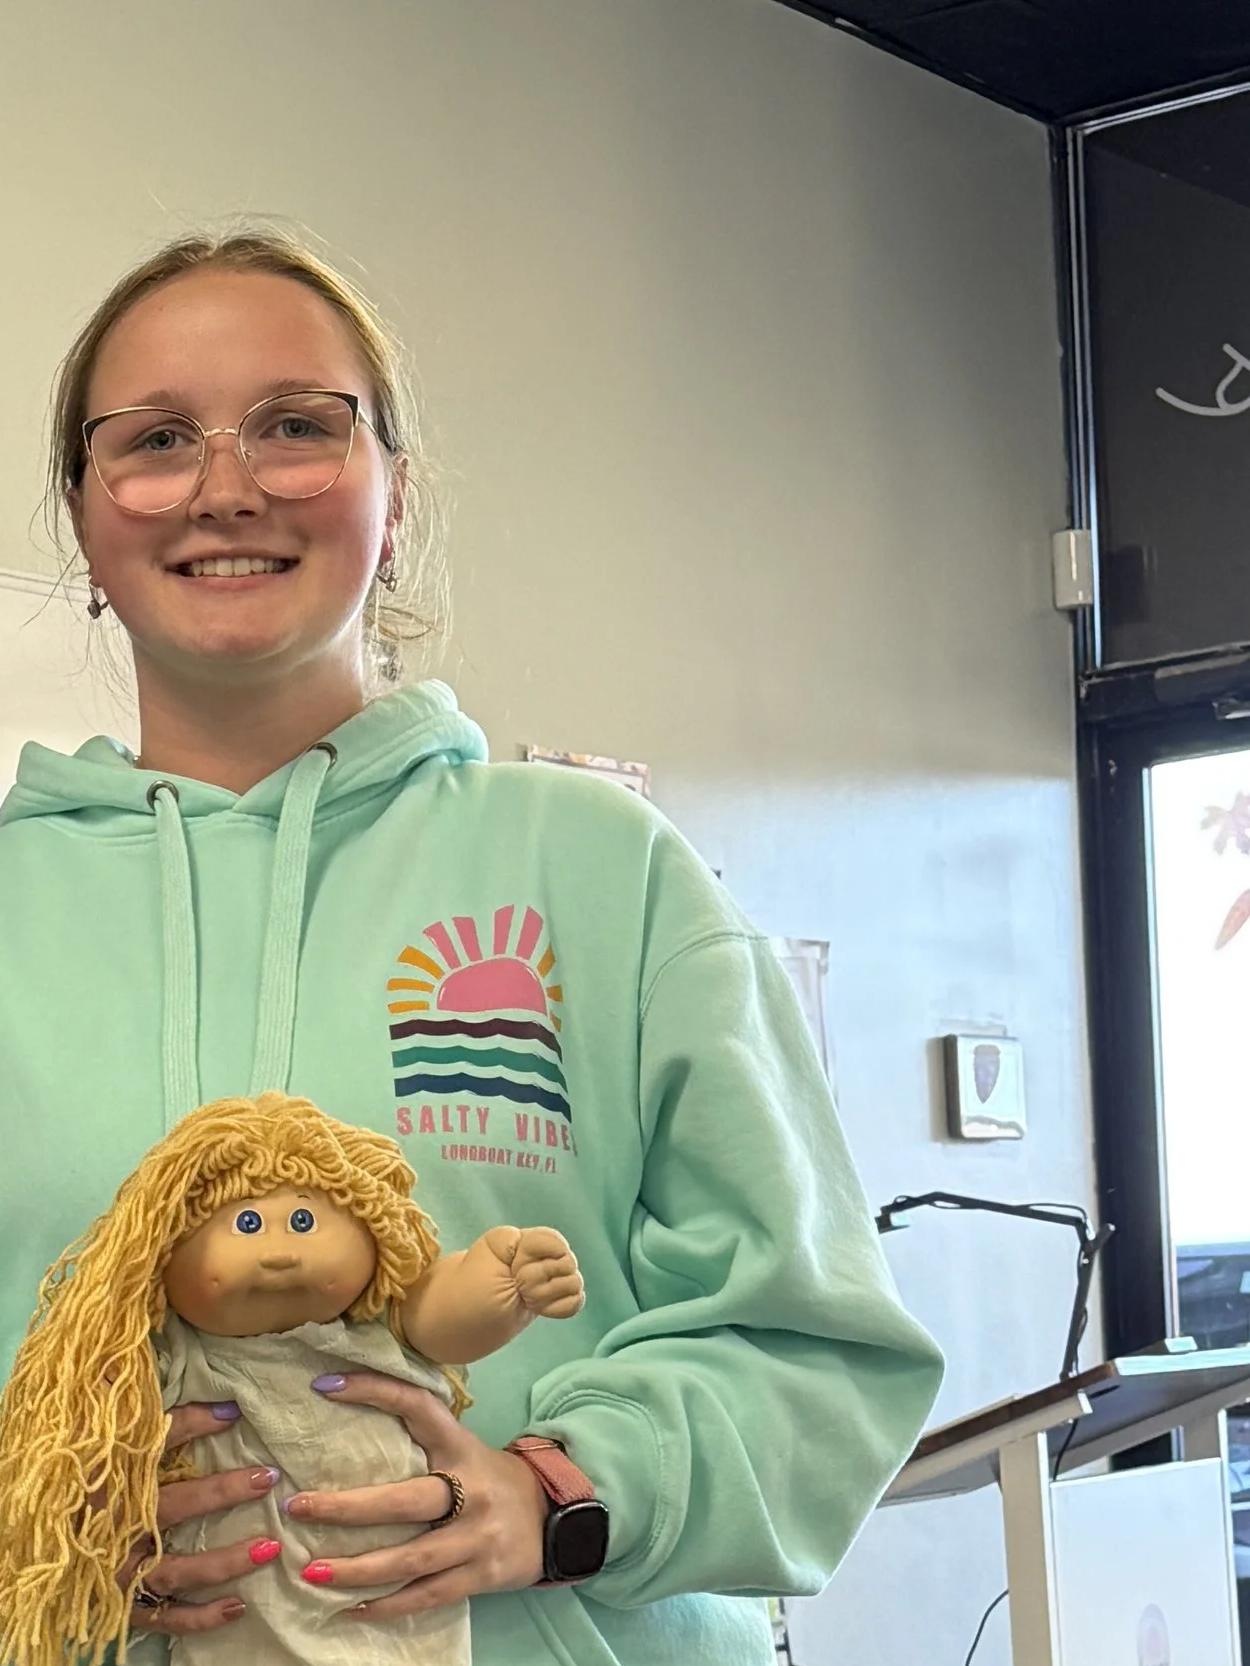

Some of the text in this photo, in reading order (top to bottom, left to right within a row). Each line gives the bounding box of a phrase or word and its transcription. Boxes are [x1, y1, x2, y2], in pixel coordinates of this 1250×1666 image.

[396, 1104, 577, 1157] SALTY VIBE
[441, 1144, 513, 1165] LONGBOAT
